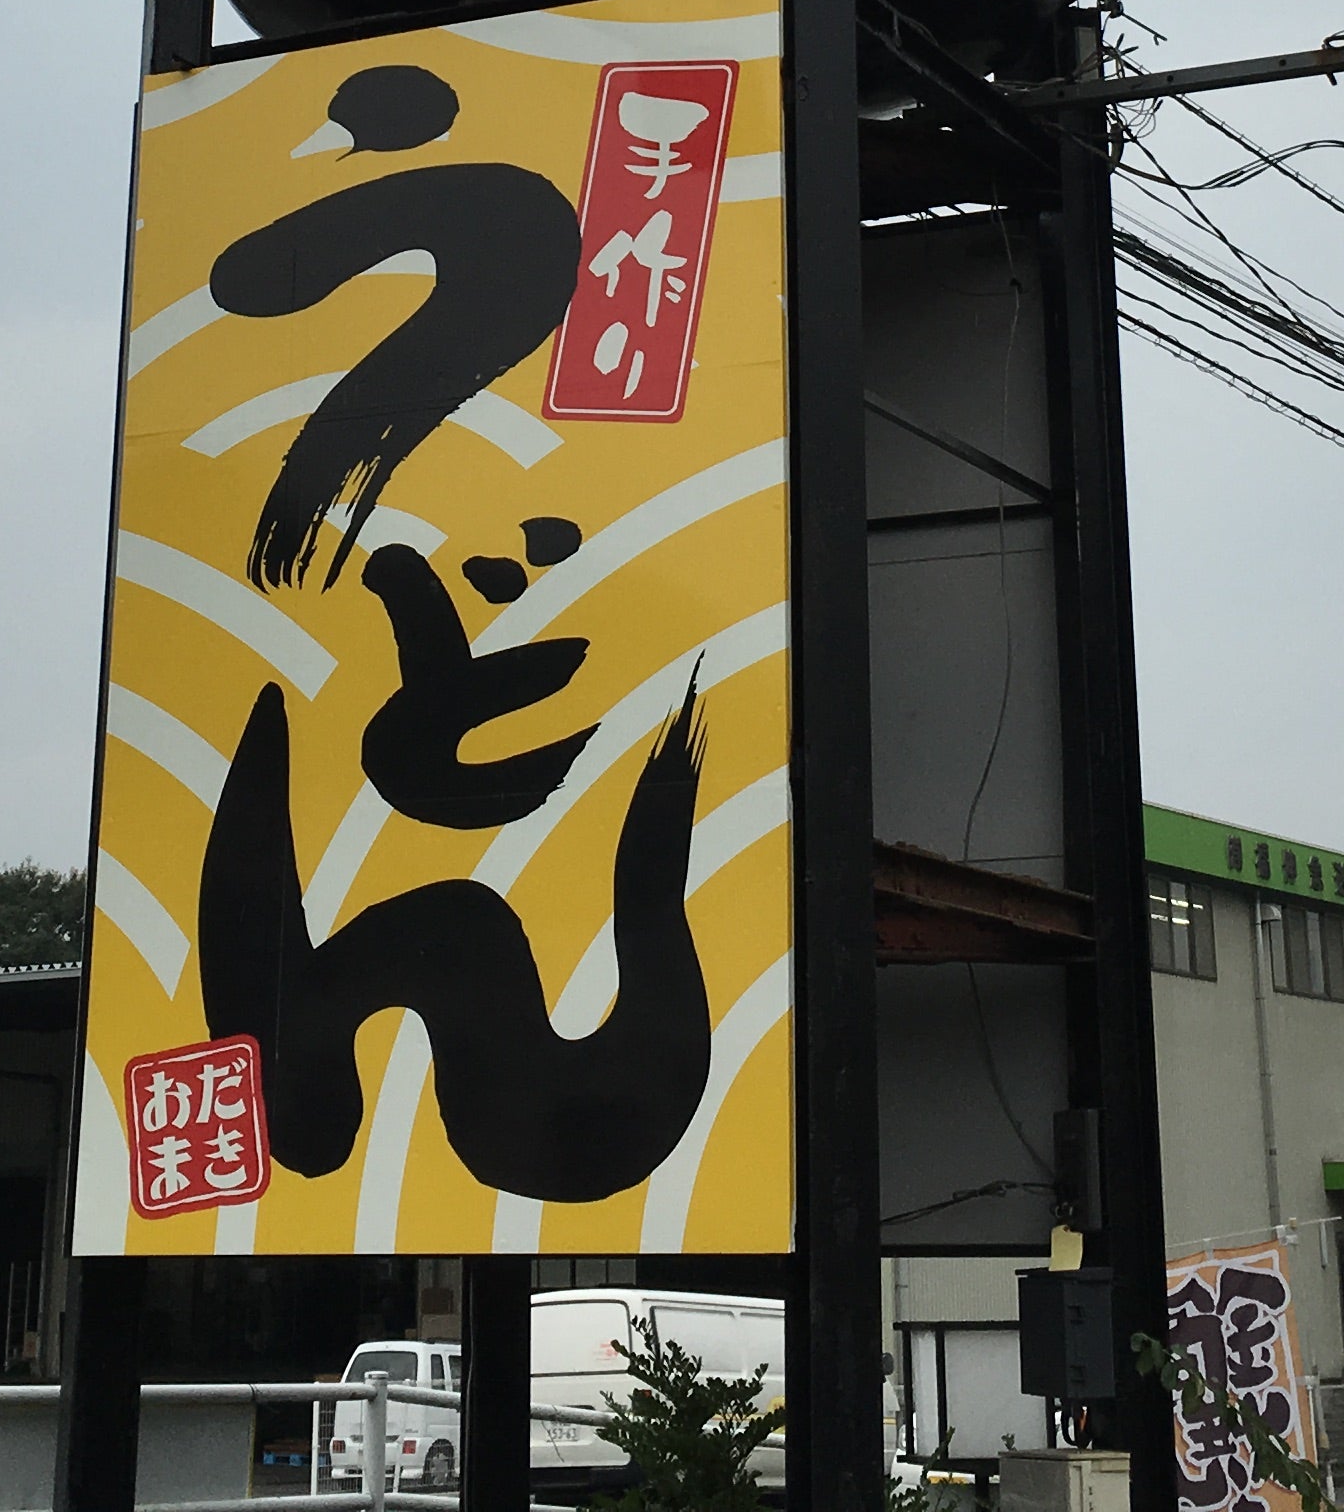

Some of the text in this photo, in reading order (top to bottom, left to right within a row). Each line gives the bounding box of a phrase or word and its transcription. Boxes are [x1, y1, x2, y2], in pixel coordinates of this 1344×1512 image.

[588, 91, 709, 400] 手作り
[198, 64, 712, 1204] うどん
